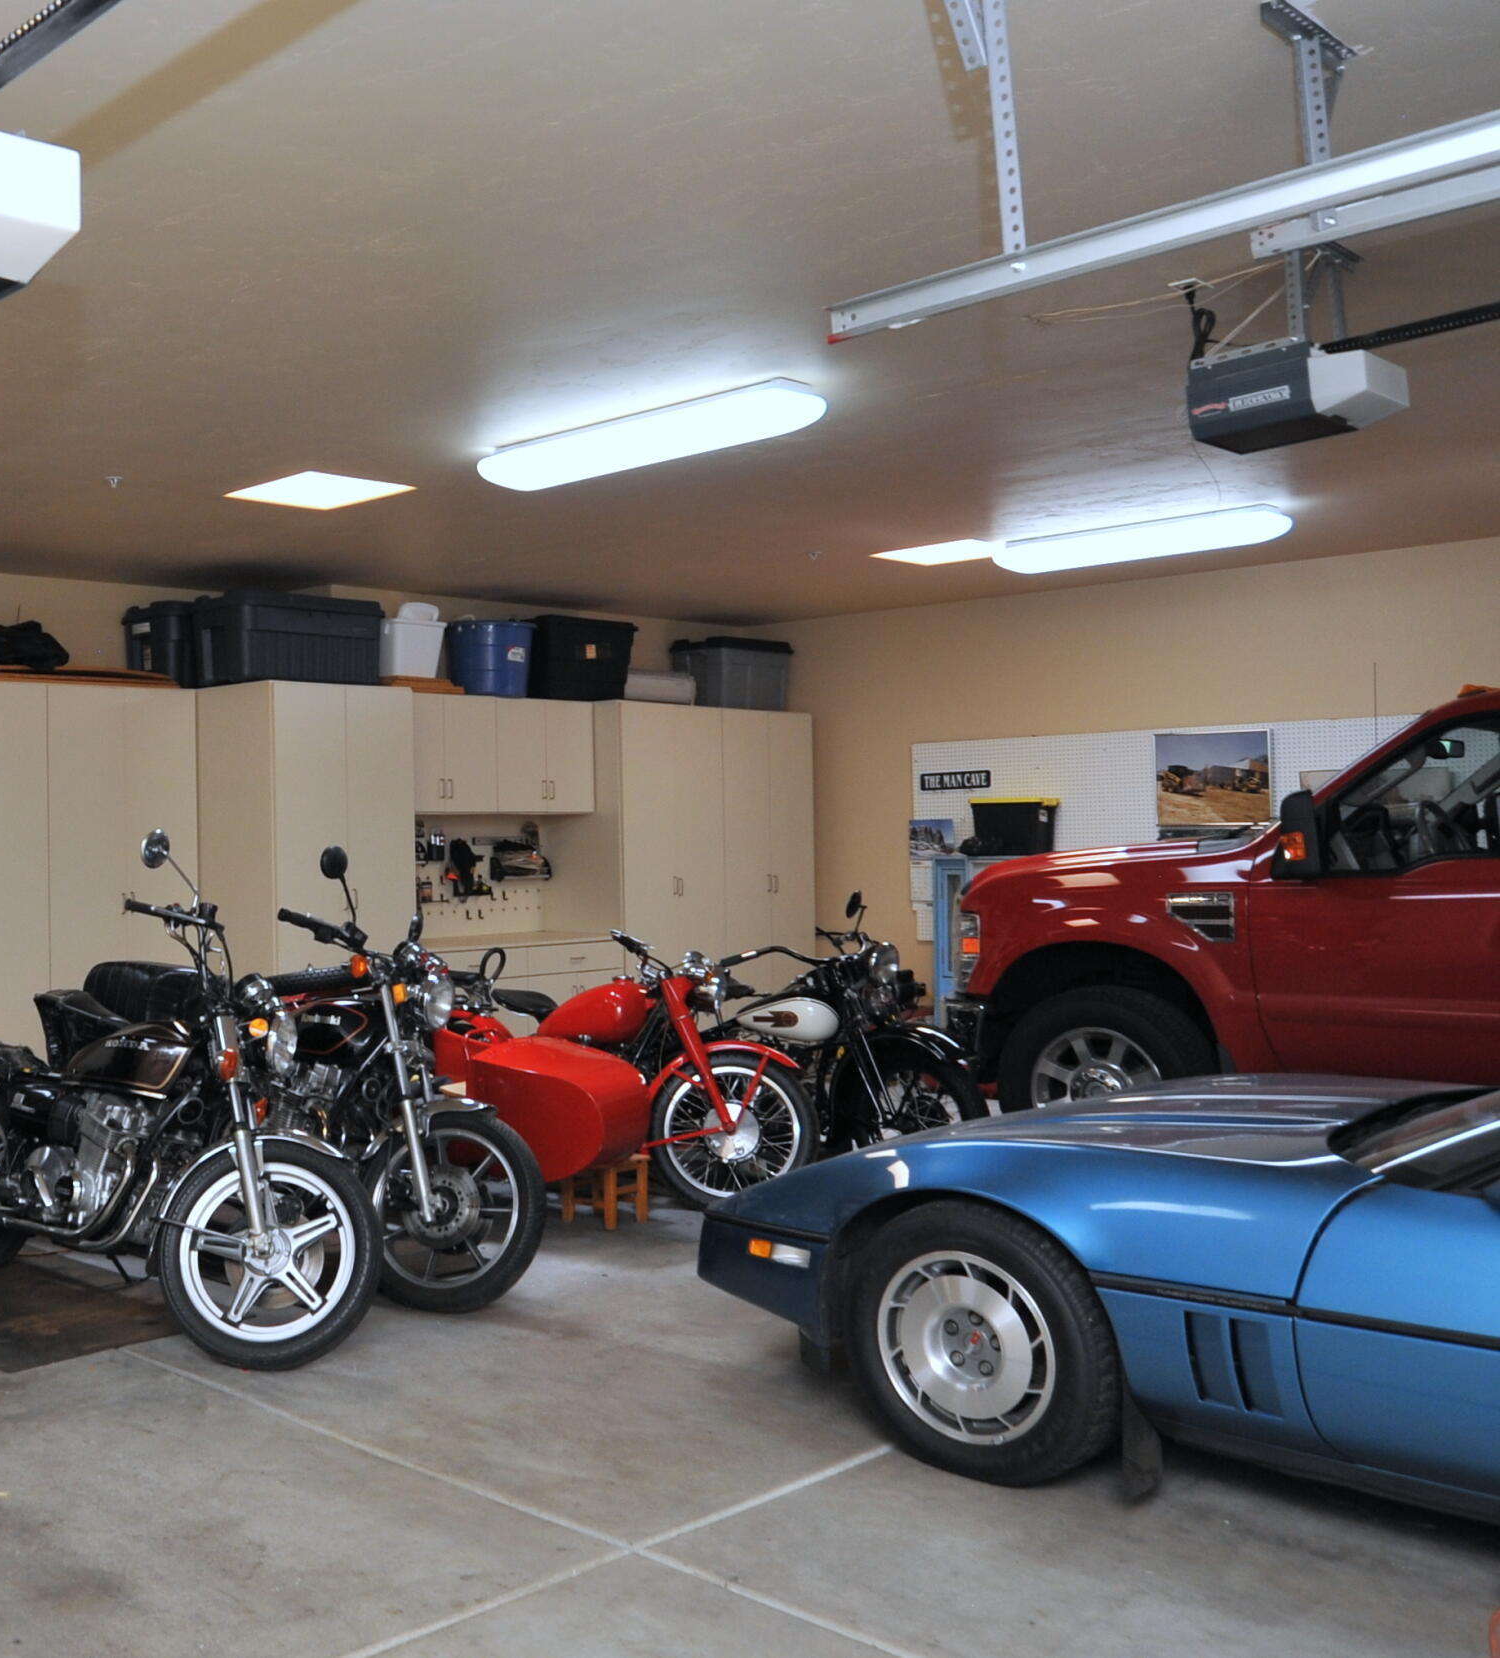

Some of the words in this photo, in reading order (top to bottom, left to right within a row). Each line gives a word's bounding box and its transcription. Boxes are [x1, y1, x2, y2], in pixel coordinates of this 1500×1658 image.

[923, 775, 941, 789] THE
[943, 773, 963, 788] MAN
[963, 772, 988, 787] CAVE
